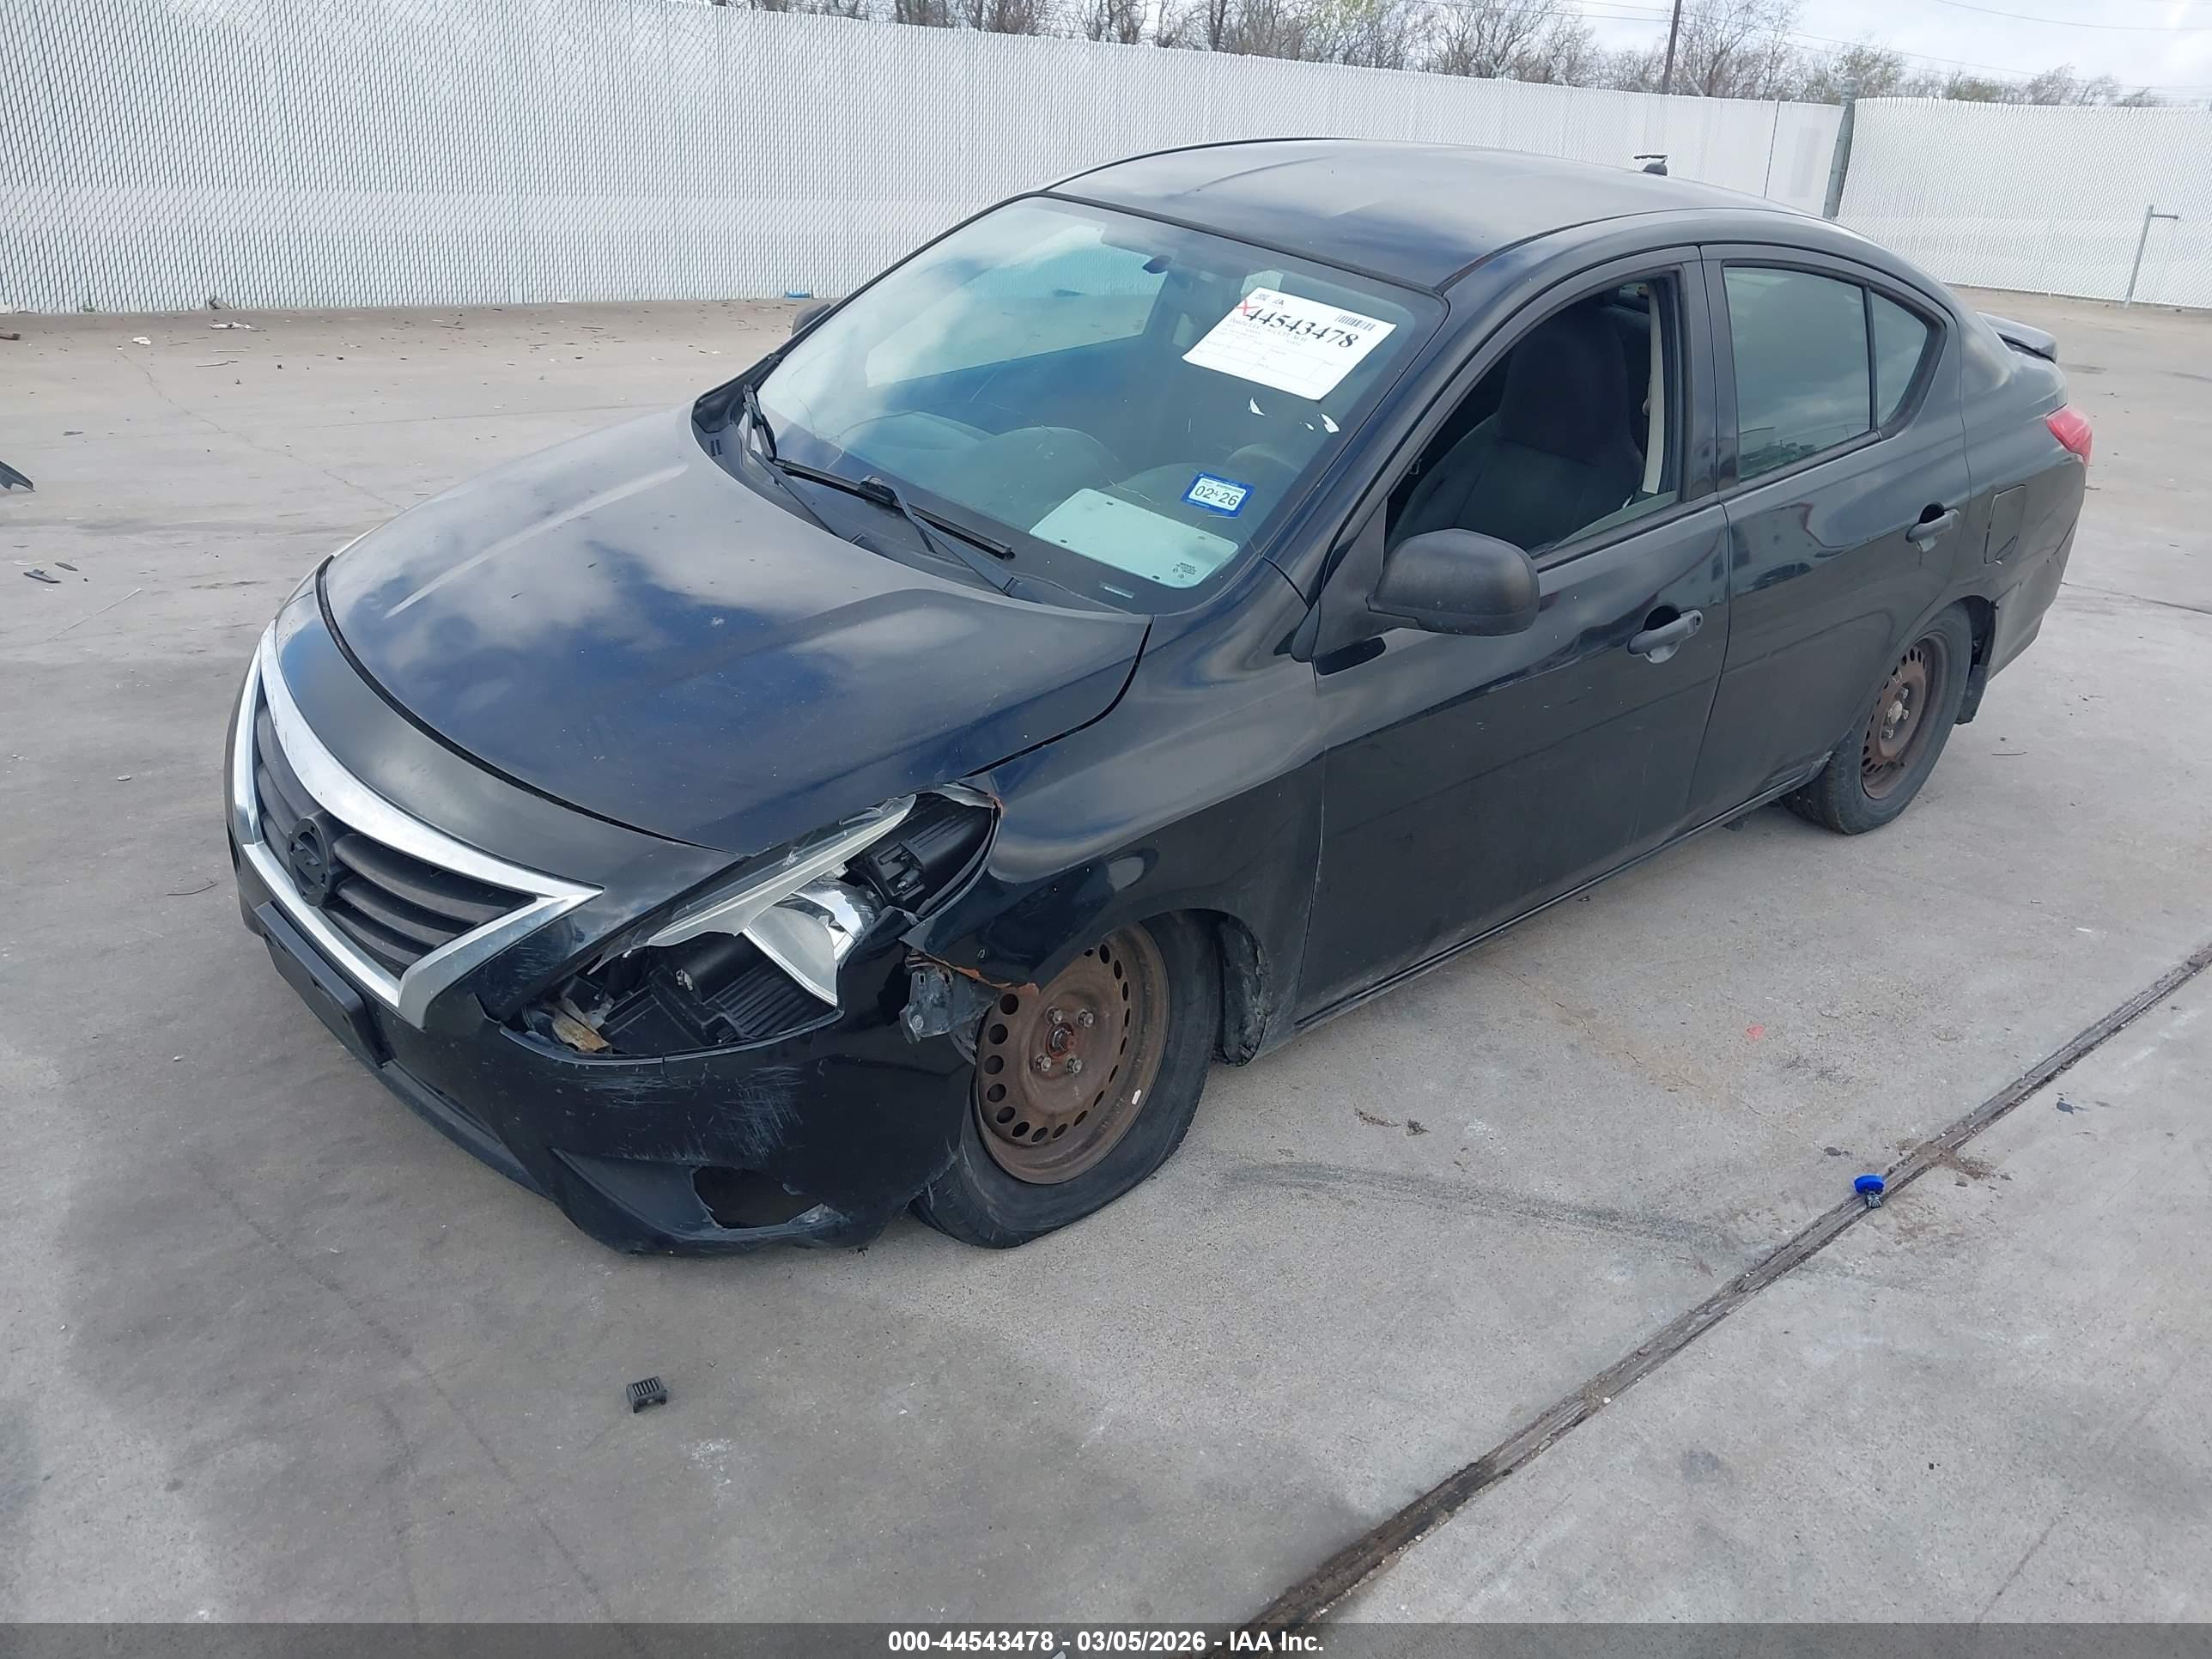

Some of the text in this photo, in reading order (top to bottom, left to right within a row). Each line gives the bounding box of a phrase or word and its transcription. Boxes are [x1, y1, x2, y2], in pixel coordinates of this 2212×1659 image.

[1246, 309, 1359, 348] 44543478
[1194, 485, 1214, 499] 02
[1218, 492, 1239, 507] 26
